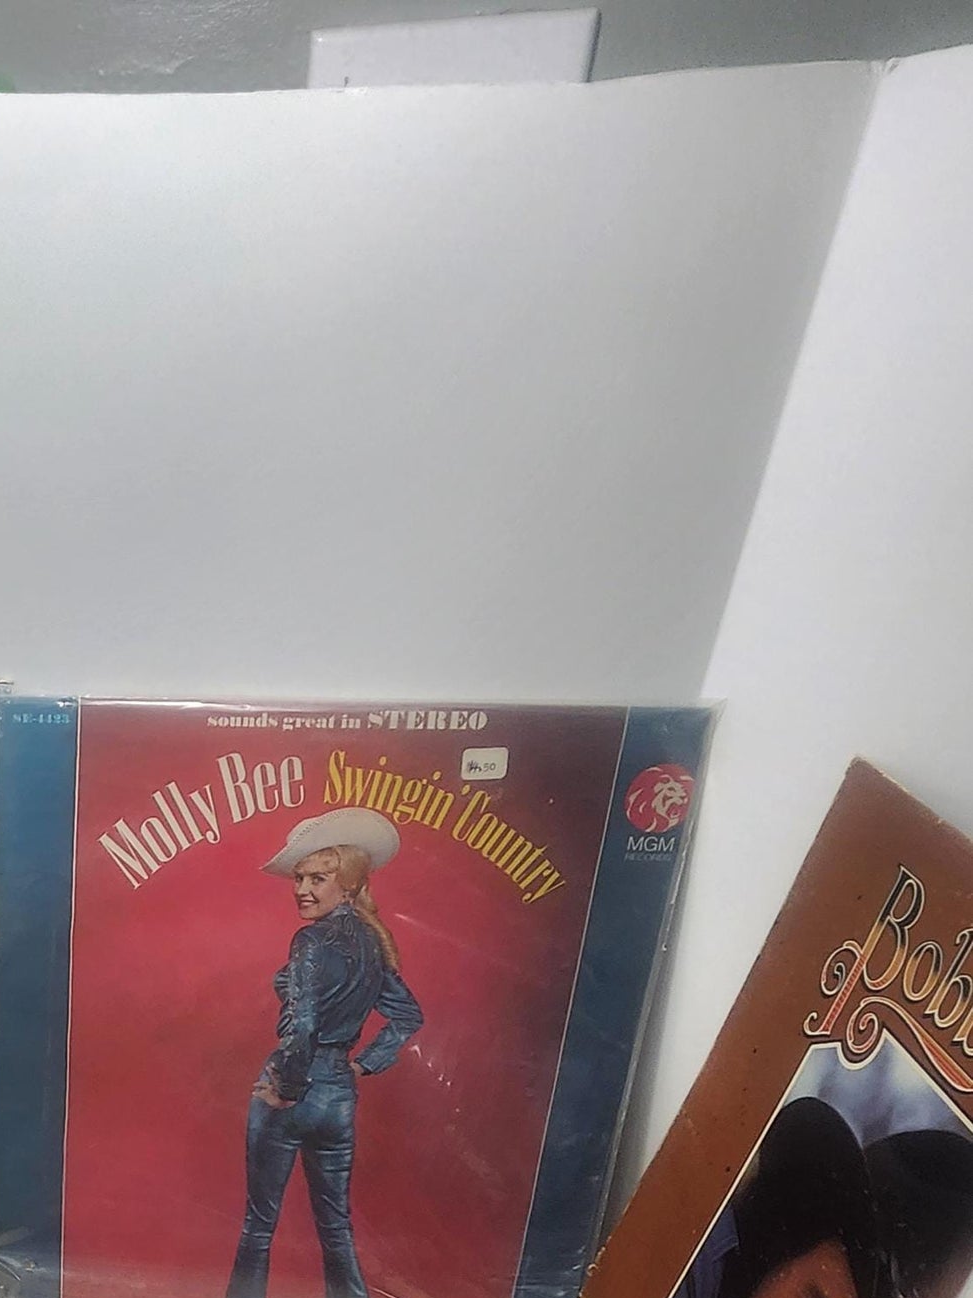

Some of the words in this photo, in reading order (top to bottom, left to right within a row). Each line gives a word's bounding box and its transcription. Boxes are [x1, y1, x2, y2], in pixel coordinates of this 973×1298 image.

[207, 713, 278, 728] sounds
[282, 714, 336, 731] great
[341, 714, 362, 729] in
[367, 710, 489, 731] STEREO
[97, 780, 221, 890] Molly
[216, 752, 306, 823] Bee
[451, 789, 566, 904] Country
[627, 836, 675, 852] MGM
